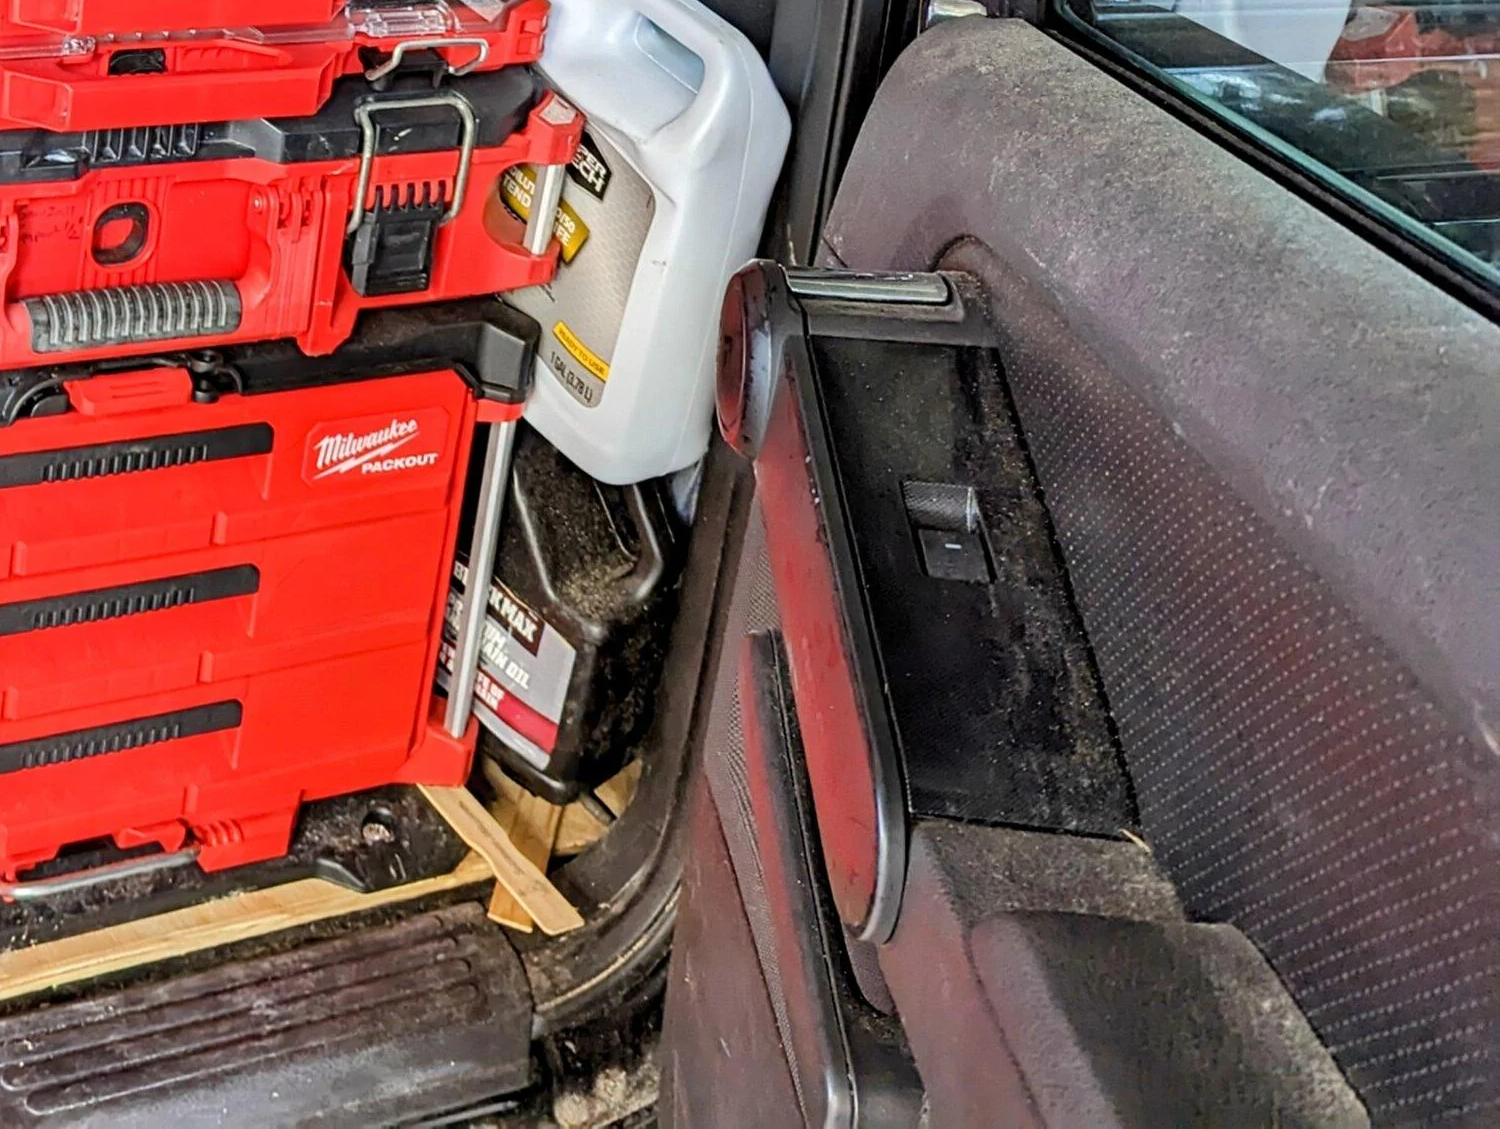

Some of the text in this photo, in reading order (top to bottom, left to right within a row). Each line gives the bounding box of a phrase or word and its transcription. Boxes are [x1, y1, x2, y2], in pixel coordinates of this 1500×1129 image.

[571, 153, 605, 193] ECH
[313, 418, 418, 470] Milwaukee
[361, 453, 438, 474] PACKOUT
